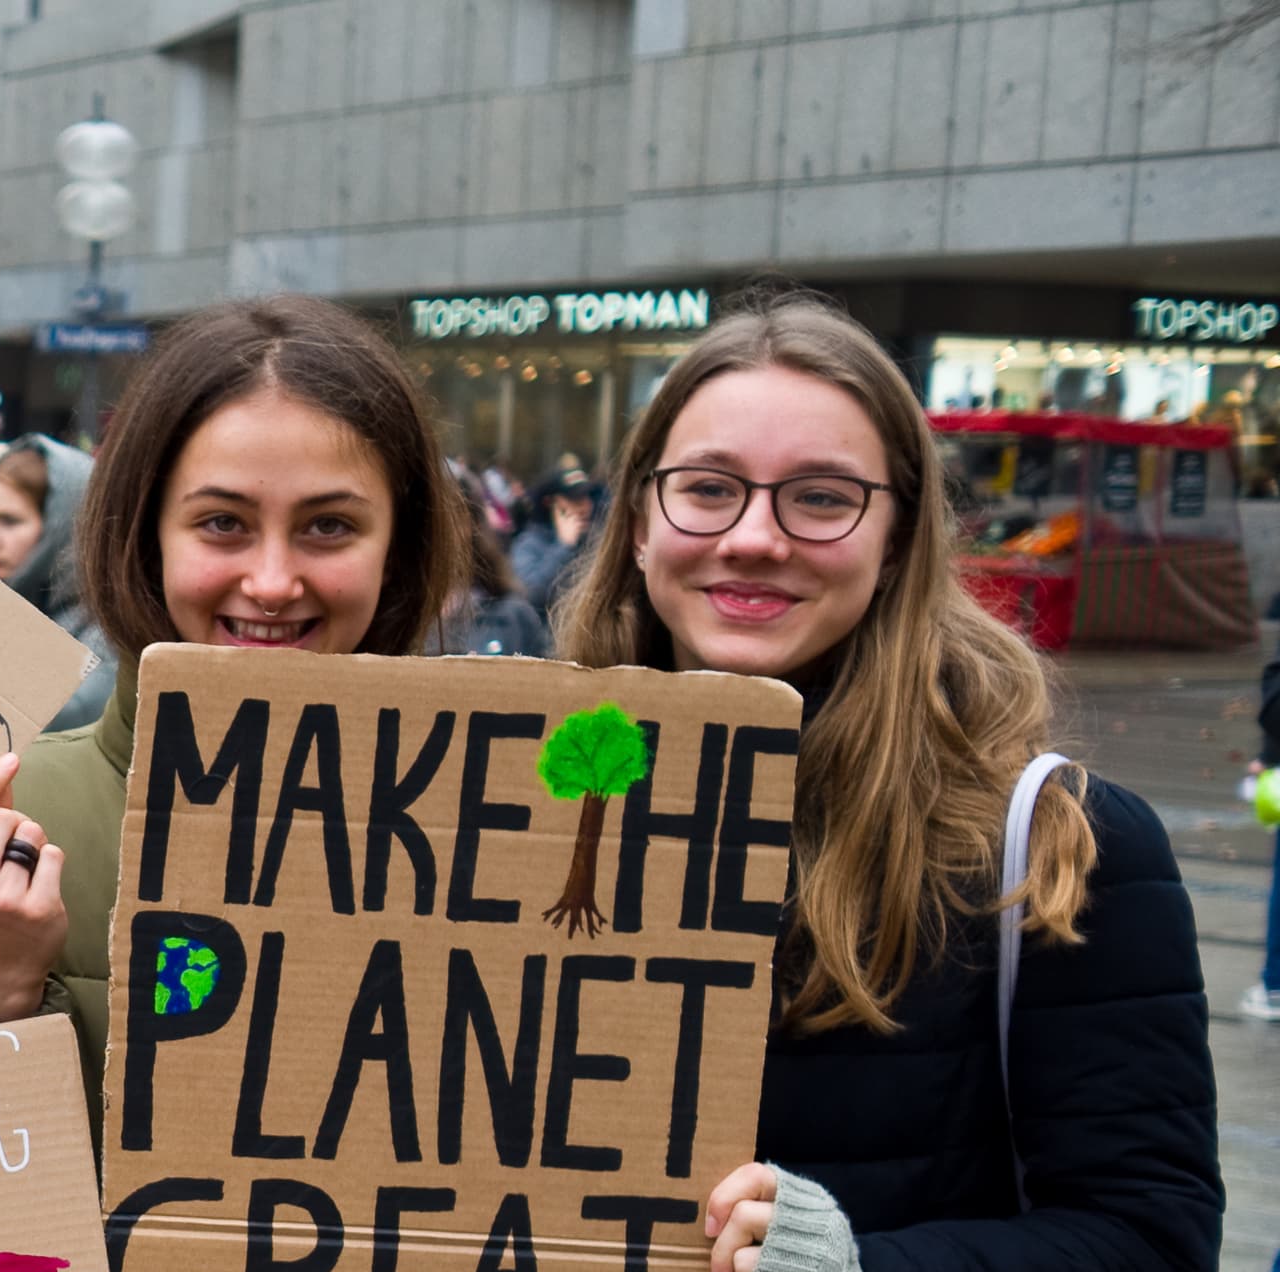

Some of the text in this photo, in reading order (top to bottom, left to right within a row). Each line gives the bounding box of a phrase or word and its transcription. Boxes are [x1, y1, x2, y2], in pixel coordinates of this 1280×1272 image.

[411, 288, 709, 337] TOPSHOP TOPMAN
[1132, 298, 1279, 341] TOPSHOP
[138, 691, 547, 924] MAKE
[121, 910, 757, 1179] PLANET
